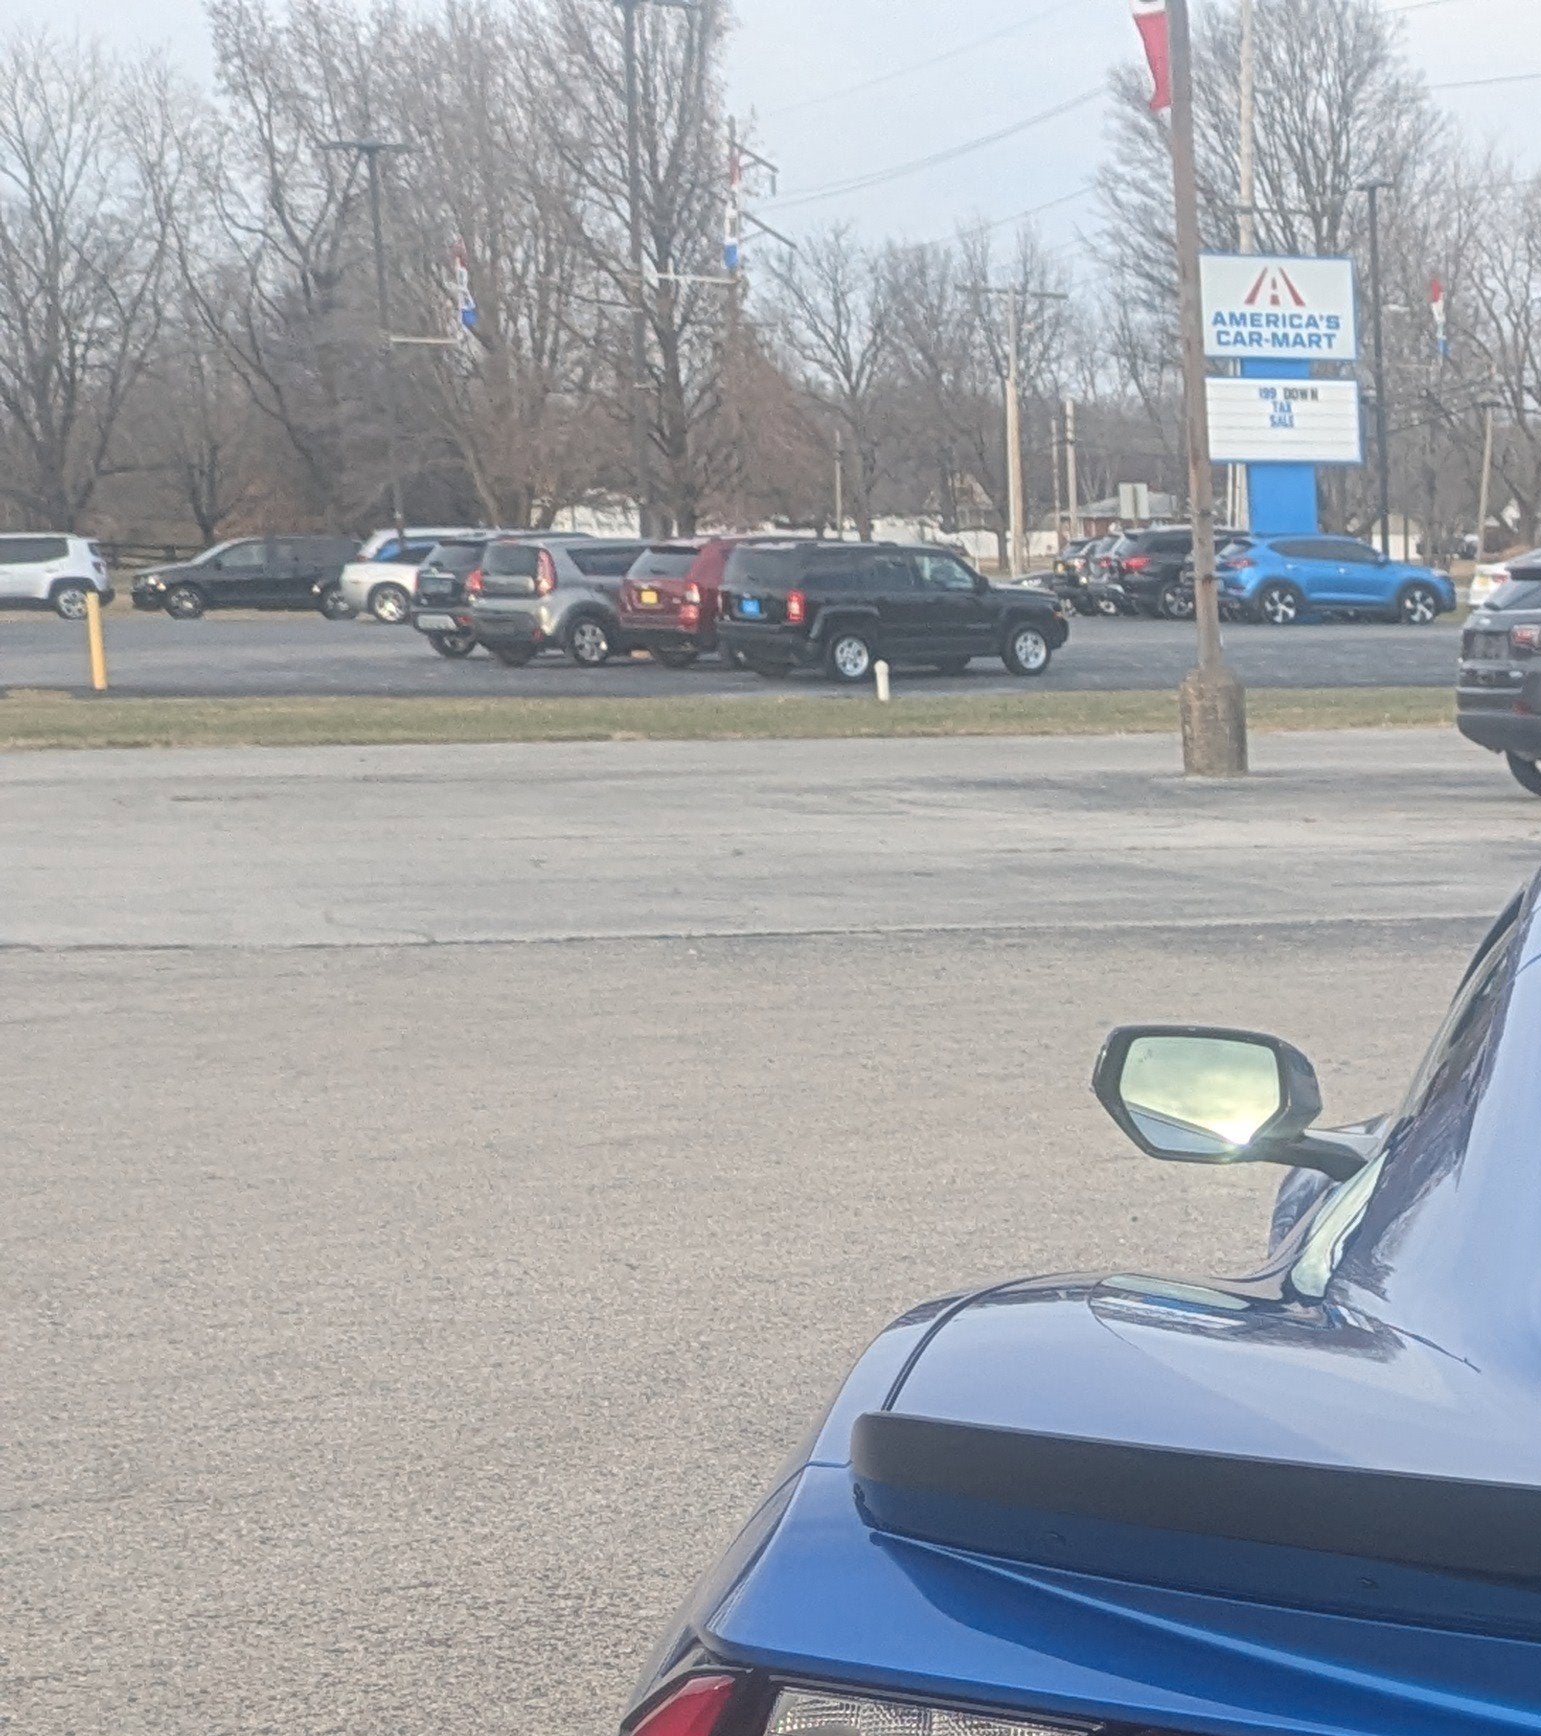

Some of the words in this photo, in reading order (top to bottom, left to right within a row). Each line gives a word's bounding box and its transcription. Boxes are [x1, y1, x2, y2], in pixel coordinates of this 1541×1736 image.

[1211, 311, 1341, 330] AMERICA'S
[1216, 330, 1337, 349] CAR-MART
[1283, 387, 1318, 401] DOWN
[1272, 401, 1292, 413] TAX
